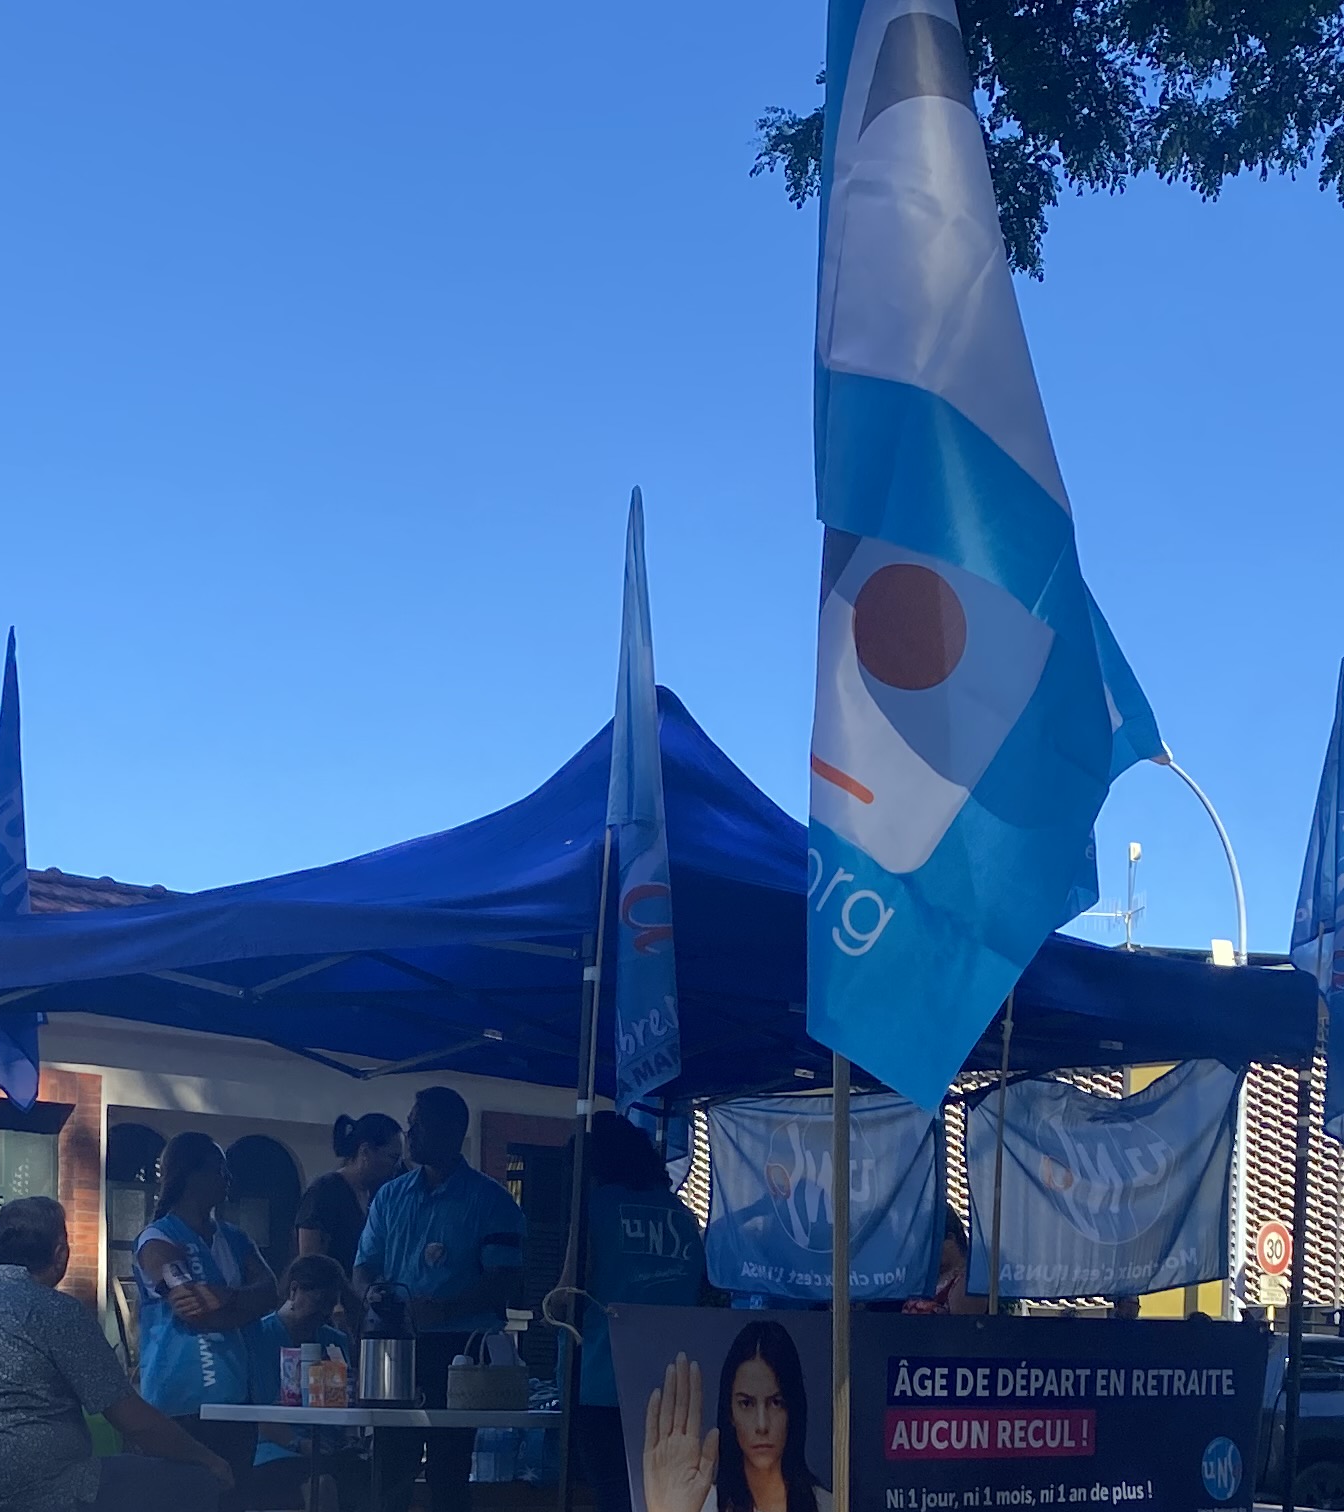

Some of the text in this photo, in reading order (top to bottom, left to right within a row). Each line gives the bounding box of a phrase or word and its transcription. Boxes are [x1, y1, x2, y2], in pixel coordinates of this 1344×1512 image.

[1266, 1238, 1283, 1260] 30
[893, 1359, 1235, 1397] ÂGE DE DÉPART EN RETRAITE
[891, 1420, 989, 1450] AUCUN
[997, 1419, 1076, 1449] RECUL
[886, 1488, 904, 1509] Ni
[908, 1488, 918, 1508] 1
[920, 1487, 959, 1512] jour,
[963, 1486, 980, 1506] ni
[983, 1486, 993, 1506] 1
[996, 1484, 1036, 1506] mois,
[1040, 1483, 1054, 1503] ni
[1057, 1483, 1066, 1502] 1
[1069, 1487, 1087, 1502] an
[1090, 1482, 1109, 1501] de
[1112, 1480, 1144, 1505] plus
